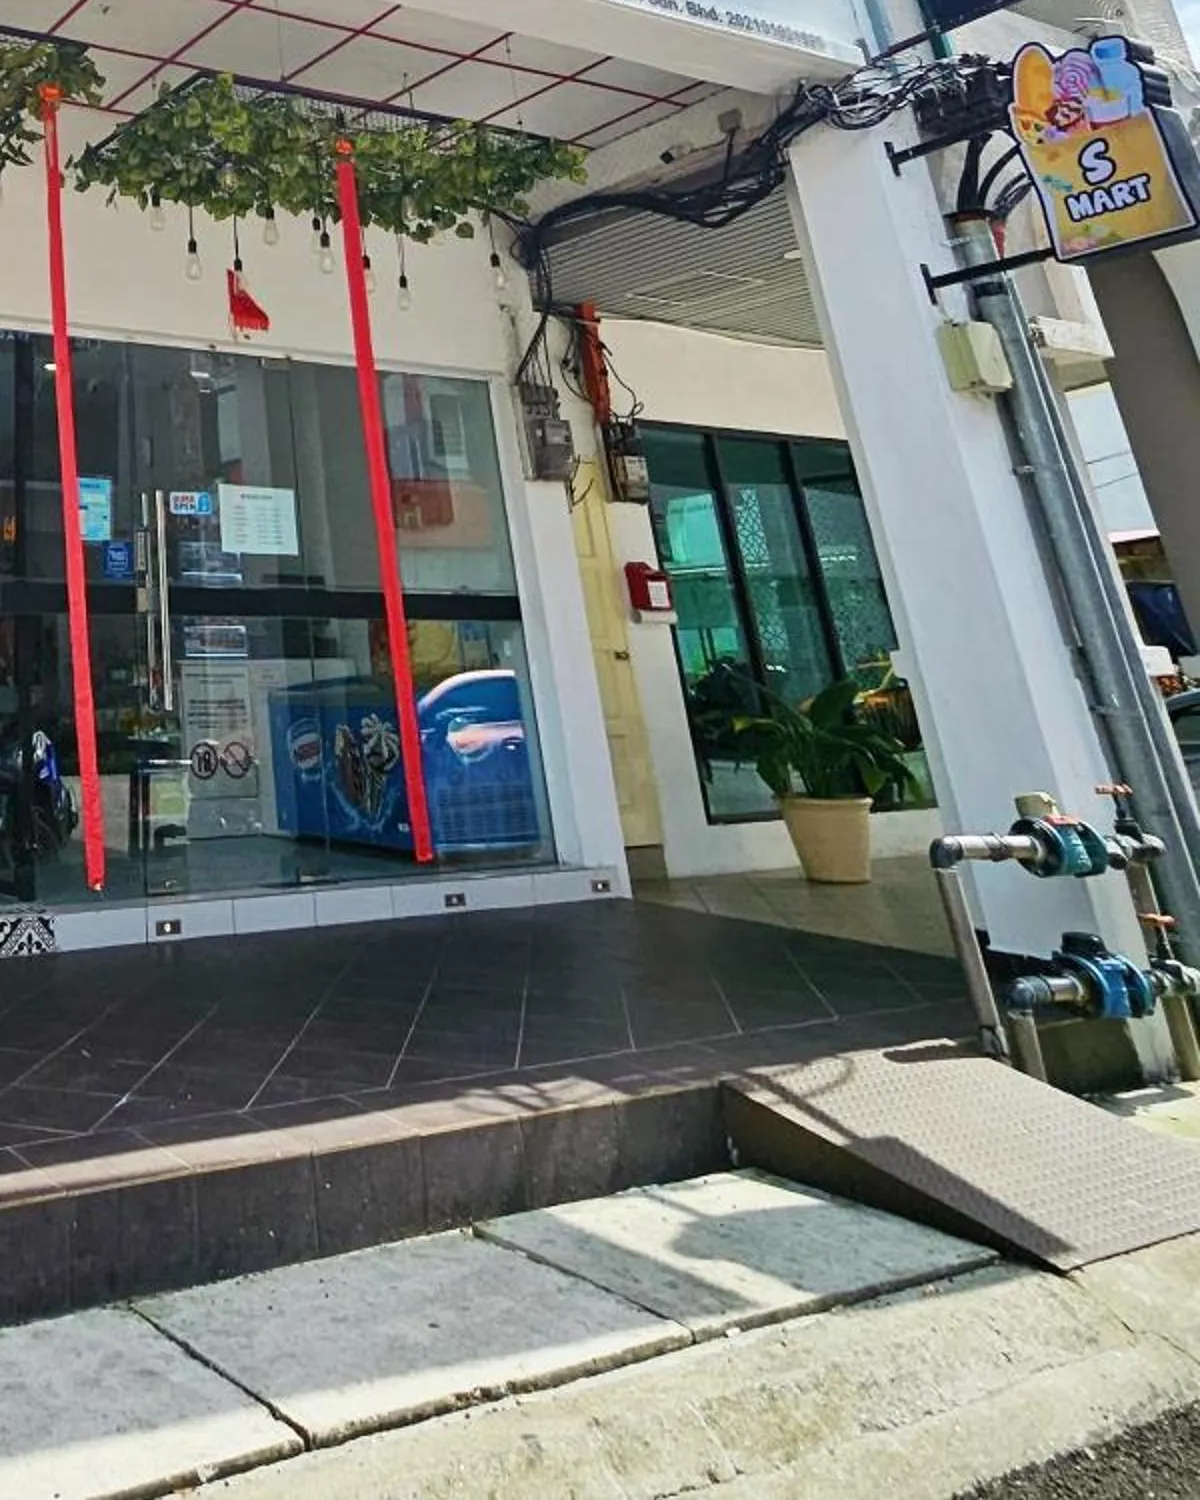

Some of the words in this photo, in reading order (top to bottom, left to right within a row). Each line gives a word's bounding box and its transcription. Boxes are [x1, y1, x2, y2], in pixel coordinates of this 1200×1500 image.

[686, 0, 723, 24] Bhd.
[1080, 138, 1116, 185] S
[1065, 174, 1151, 222] MART
